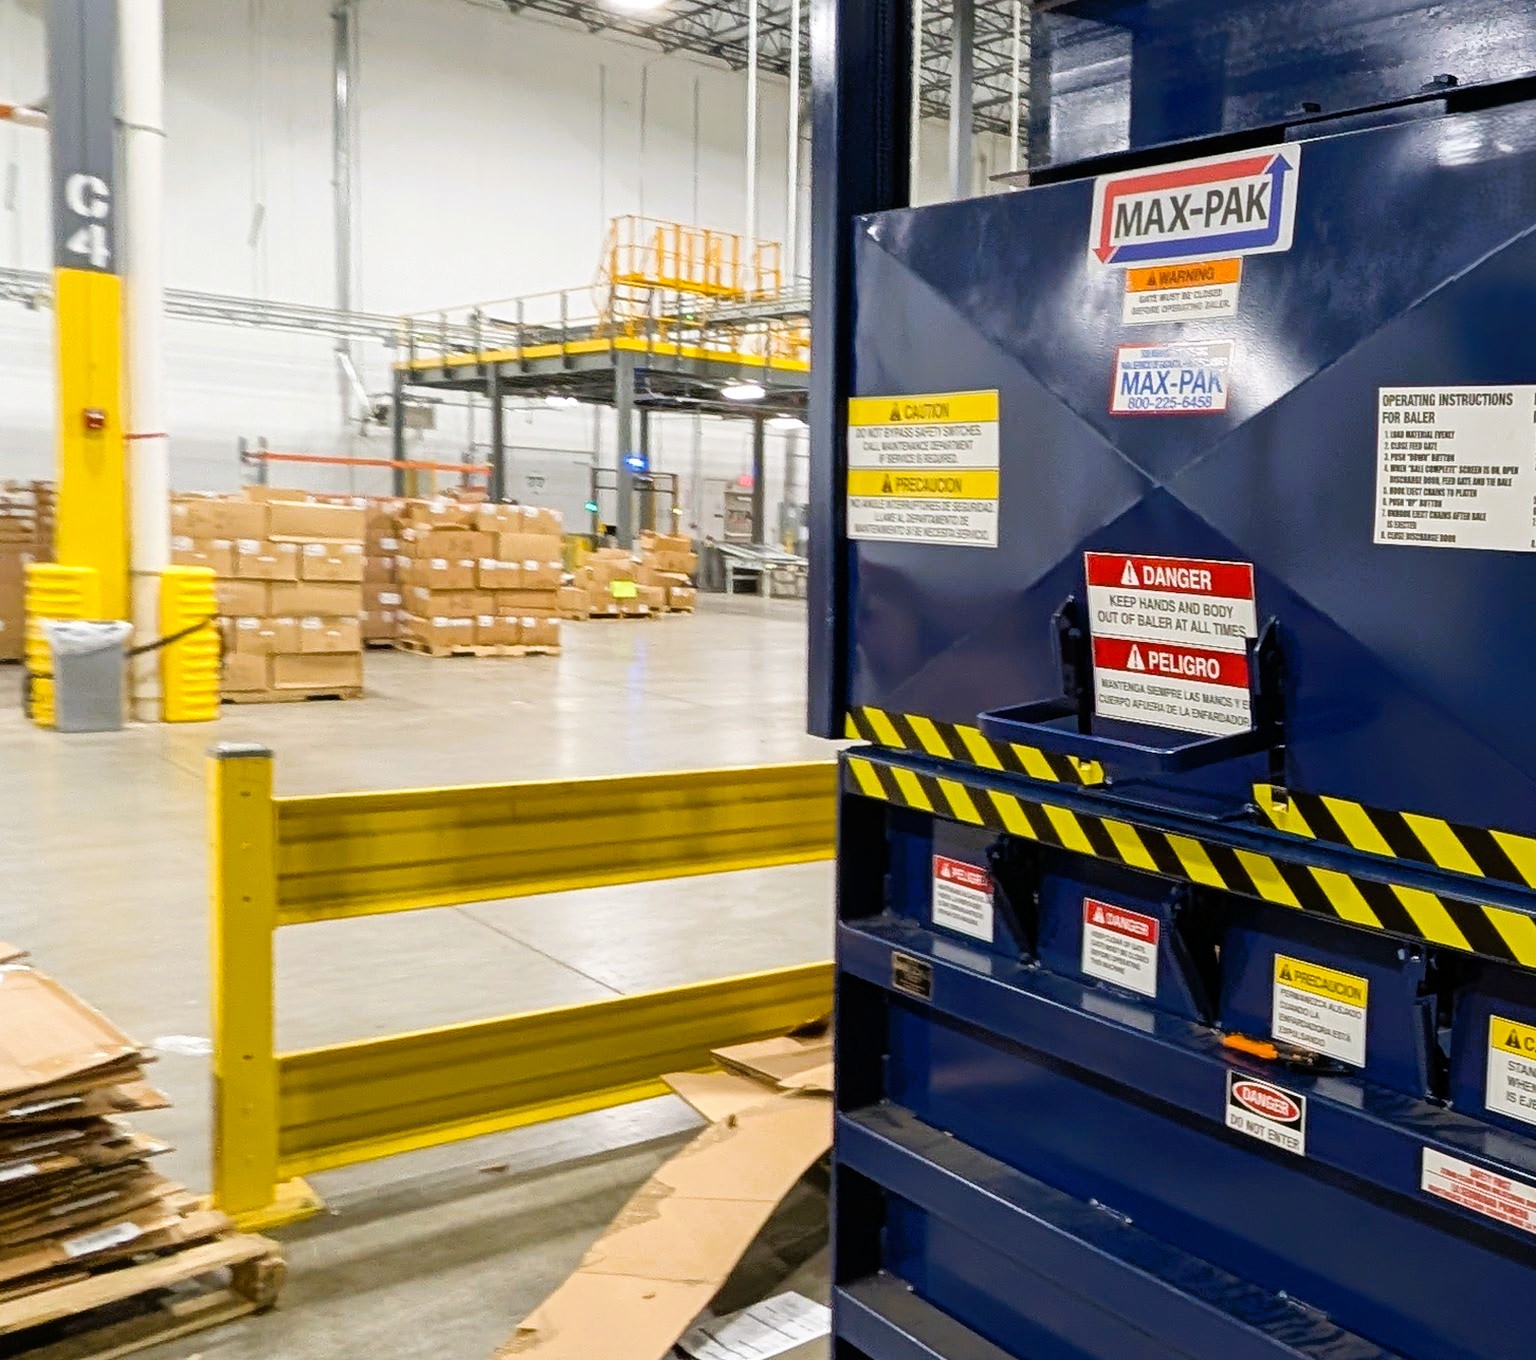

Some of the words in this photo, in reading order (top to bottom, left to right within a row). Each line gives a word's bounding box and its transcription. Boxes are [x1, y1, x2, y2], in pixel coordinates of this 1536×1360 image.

[1114, 182, 1269, 238] MAX-PAK
[1160, 267, 1214, 282] WARNING
[1121, 369, 1223, 395] MAX-PAK
[904, 403, 949, 419] CAUTION
[1382, 394, 1435, 406] OPERATING
[1439, 393, 1513, 406] INSTRUCTIONS
[1382, 412, 1399, 423] FOR
[1404, 412, 1435, 424] BALER
[1143, 566, 1211, 590] DANGER
[1110, 595, 1136, 607] KEEP
[1140, 598, 1176, 612] HANDS
[1178, 602, 1200, 615] AND
[1204, 604, 1233, 618] BODY
[1098, 611, 1118, 623] OUT
[1121, 613, 1135, 625] OF
[1138, 615, 1172, 629] BALER
[1175, 619, 1188, 630] AT
[1191, 620, 1210, 634] ALL
[1148, 651, 1220, 679] PELIGRO
[1102, 678, 1145, 692] MANTENGA
[1148, 685, 1182, 699] SIEMPRE
[1184, 691, 1200, 703] LAS
[1203, 693, 1233, 708] MANOS
[1234, 698, 1240, 709] Y
[1242, 700, 1250, 710] E
[1099, 695, 1130, 707] CUERPO
[1132, 700, 1164, 712] AFUERA
[1166, 704, 1177, 715] DE
[1180, 706, 1190, 717] LA
[1105, 912, 1149, 936] DANGER
[1242, 1087, 1289, 1116] DANGER
[1506, 1091, 1516, 1102] IS
[1231, 1114, 1243, 1128] DO
[1246, 1121, 1265, 1137] NOT
[1268, 1128, 1299, 1150] ENTER
